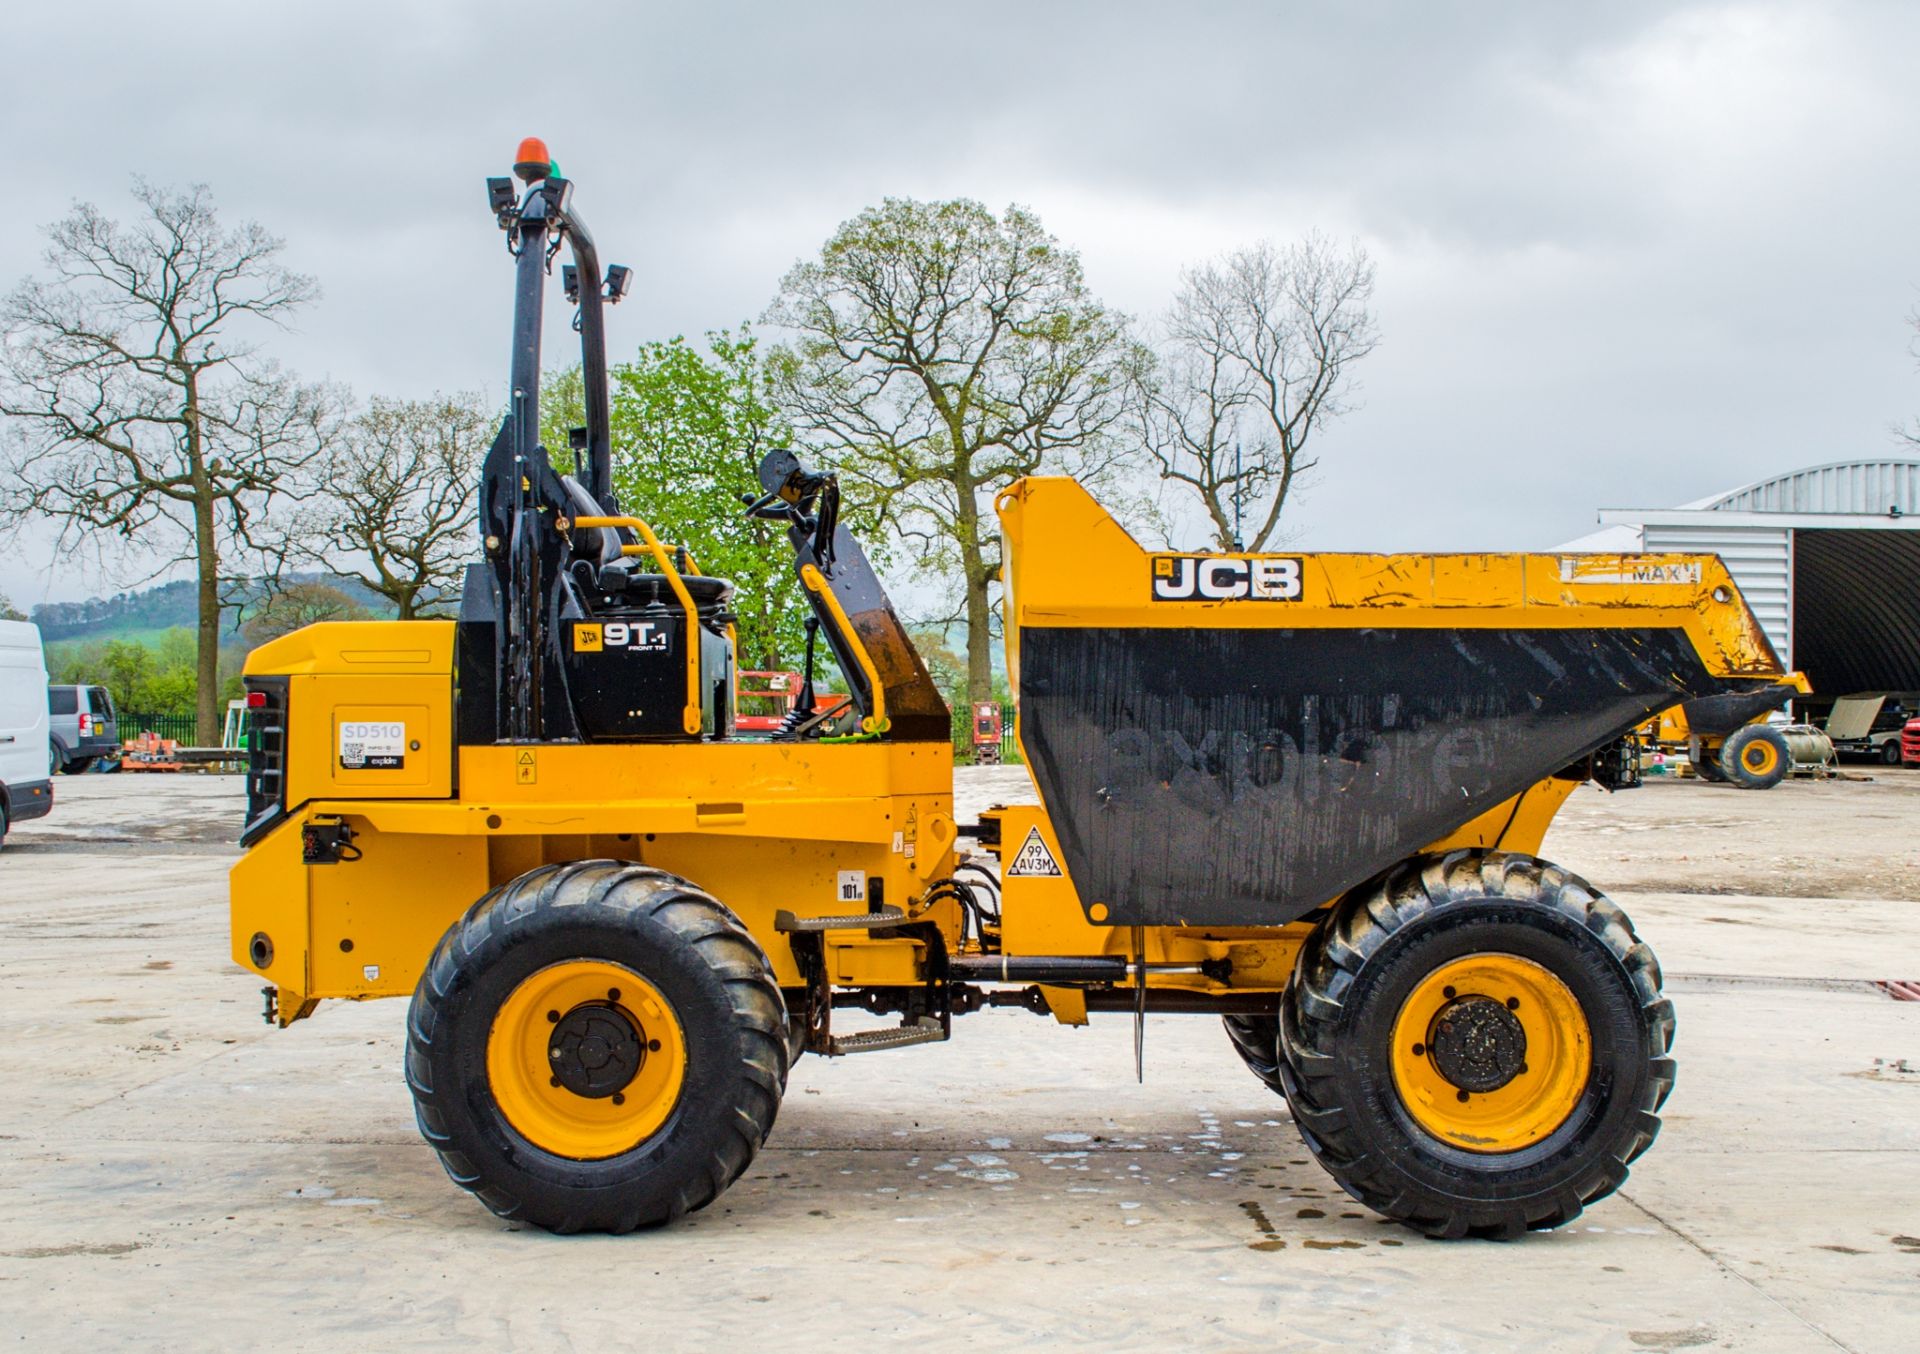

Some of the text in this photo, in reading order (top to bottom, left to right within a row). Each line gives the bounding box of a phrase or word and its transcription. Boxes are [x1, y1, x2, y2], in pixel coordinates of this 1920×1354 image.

[1155, 558, 1301, 598] JCB
[345, 725, 401, 738] SD510
[1028, 846, 1041, 857] 99
[1020, 859, 1050, 870] AV3M
[842, 884, 857, 899] 101
